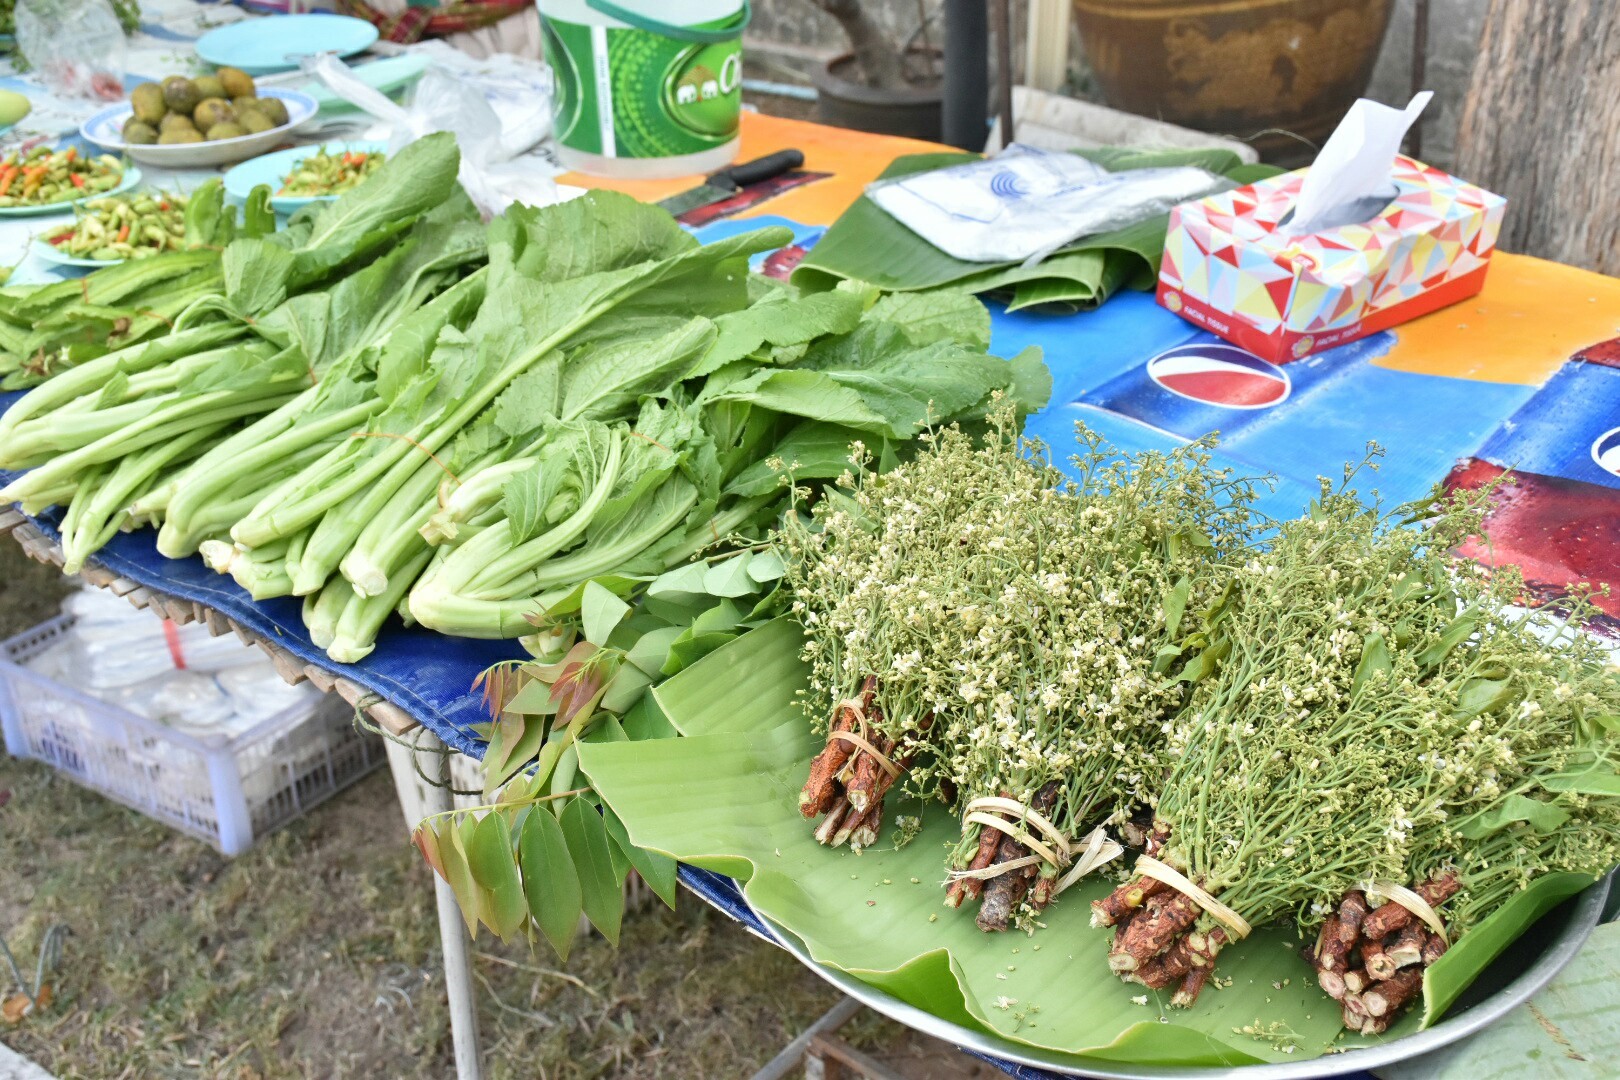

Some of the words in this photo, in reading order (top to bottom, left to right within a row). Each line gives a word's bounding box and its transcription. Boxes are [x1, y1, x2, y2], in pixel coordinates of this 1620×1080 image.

[1183, 305, 1206, 323] FACIAL
[1206, 316, 1230, 335] TISSUE
[1315, 334, 1340, 347] FACIAL
[1341, 321, 1362, 339] TISSUE
